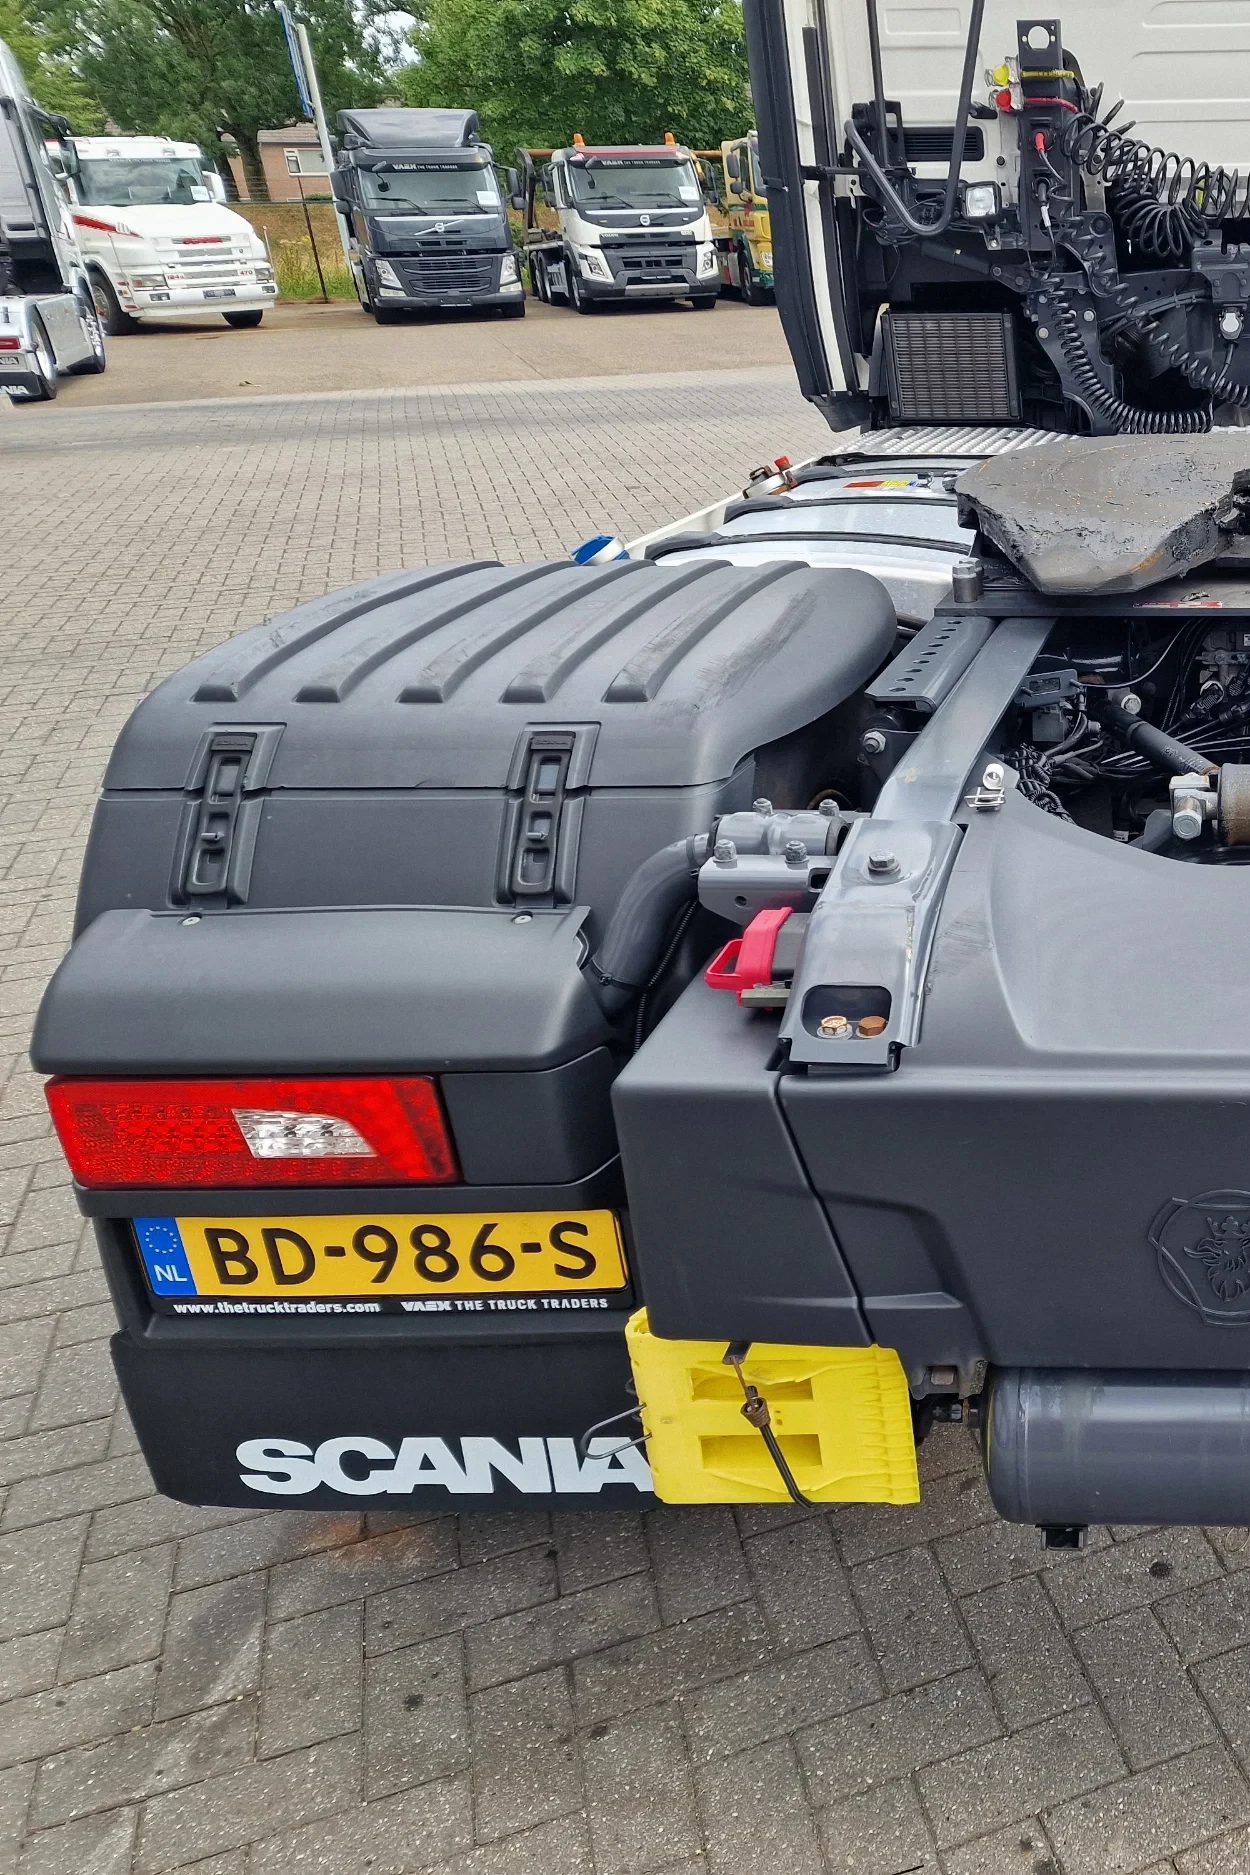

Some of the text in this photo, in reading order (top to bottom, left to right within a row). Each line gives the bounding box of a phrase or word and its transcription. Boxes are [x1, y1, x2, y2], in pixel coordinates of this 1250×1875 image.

[203, 1220, 597, 1286] BD-986-S
[153, 1264, 188, 1282] NL
[173, 1301, 381, 1314] www.thetrucktraders.com
[401, 1298, 608, 1312] VAEX THE TRUCK TRADERS
[235, 1436, 655, 1496] SCANIA
